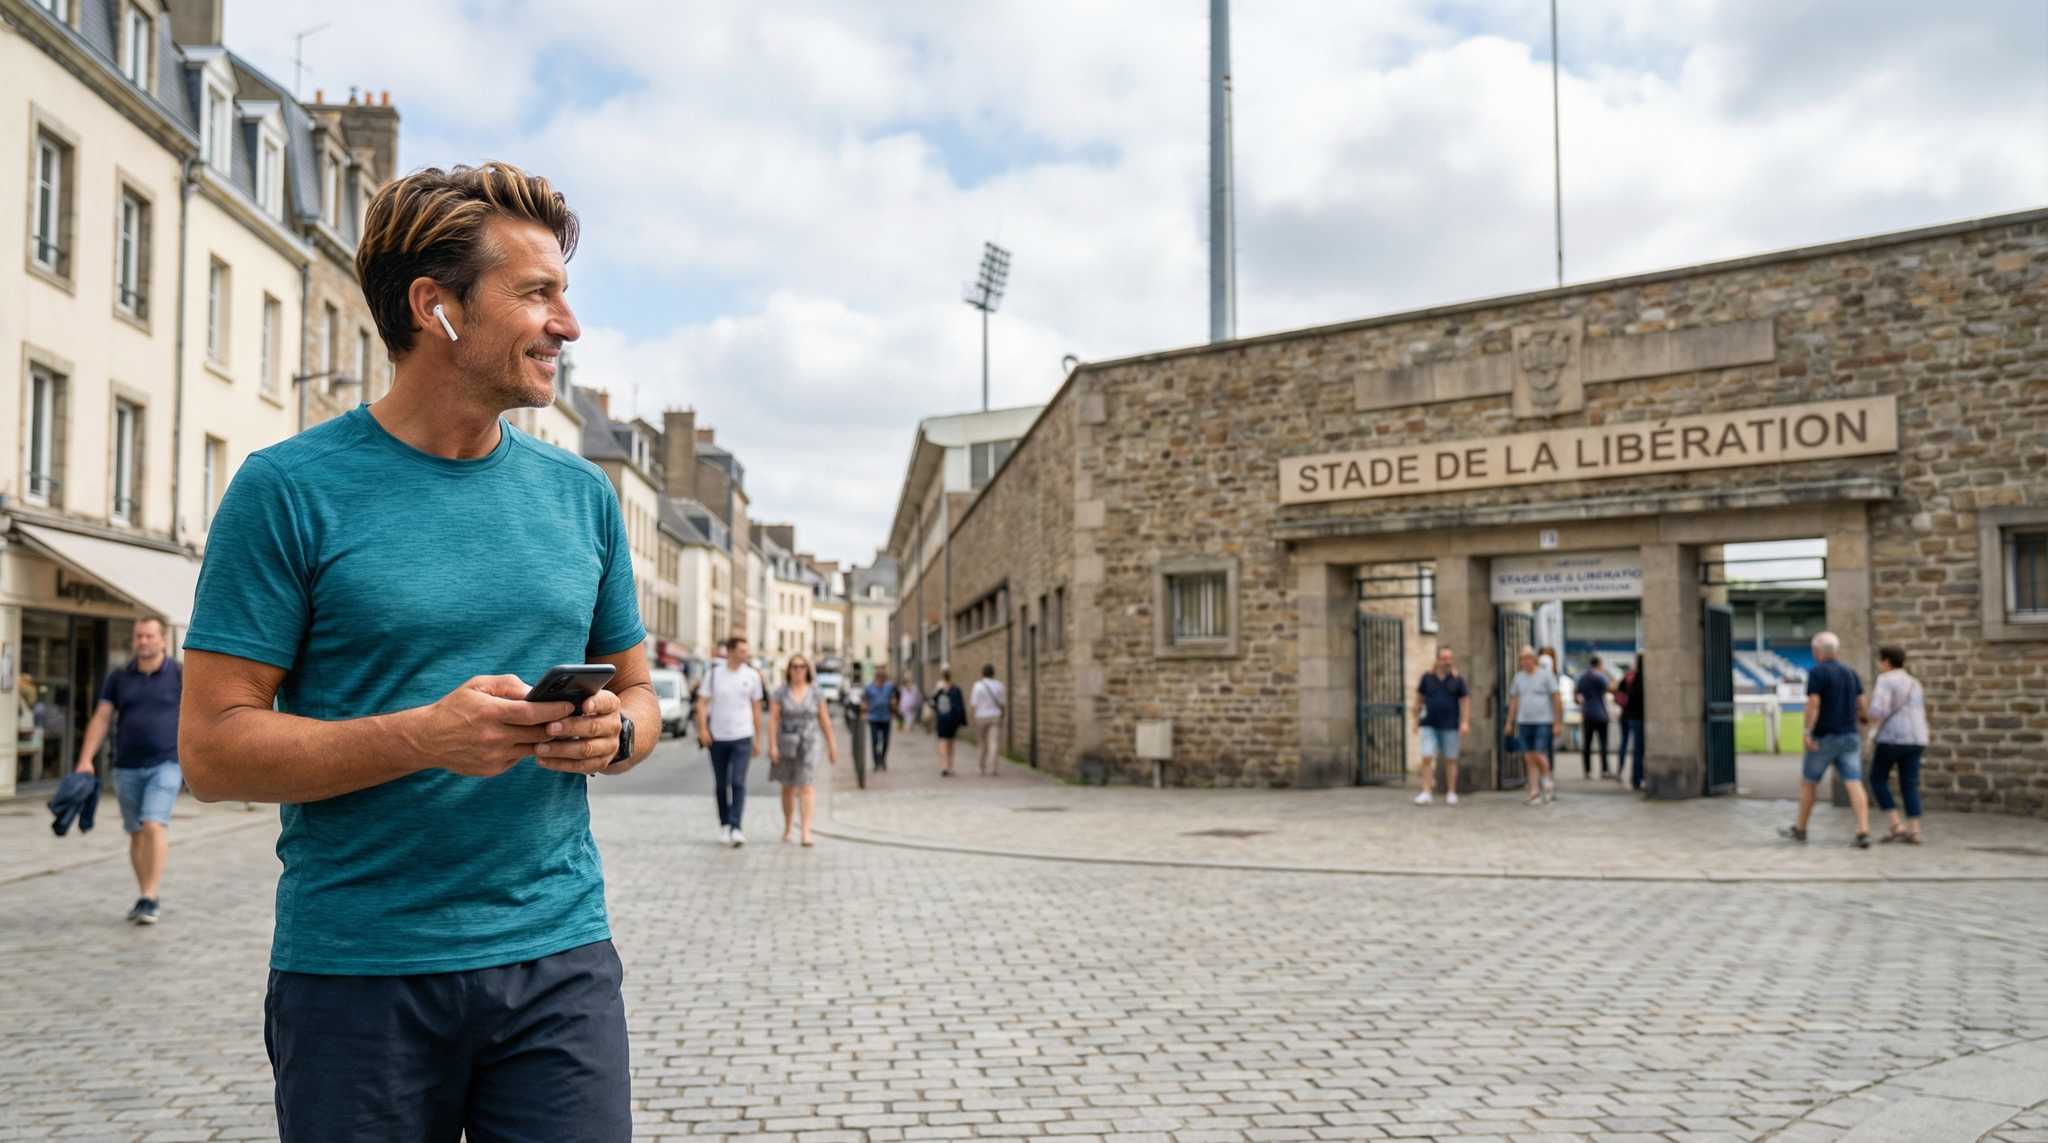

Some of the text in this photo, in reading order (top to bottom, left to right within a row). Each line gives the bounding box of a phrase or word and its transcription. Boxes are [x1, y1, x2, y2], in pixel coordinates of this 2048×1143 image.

[1298, 409, 1867, 493] STADE DE LA LIBÉRATION
